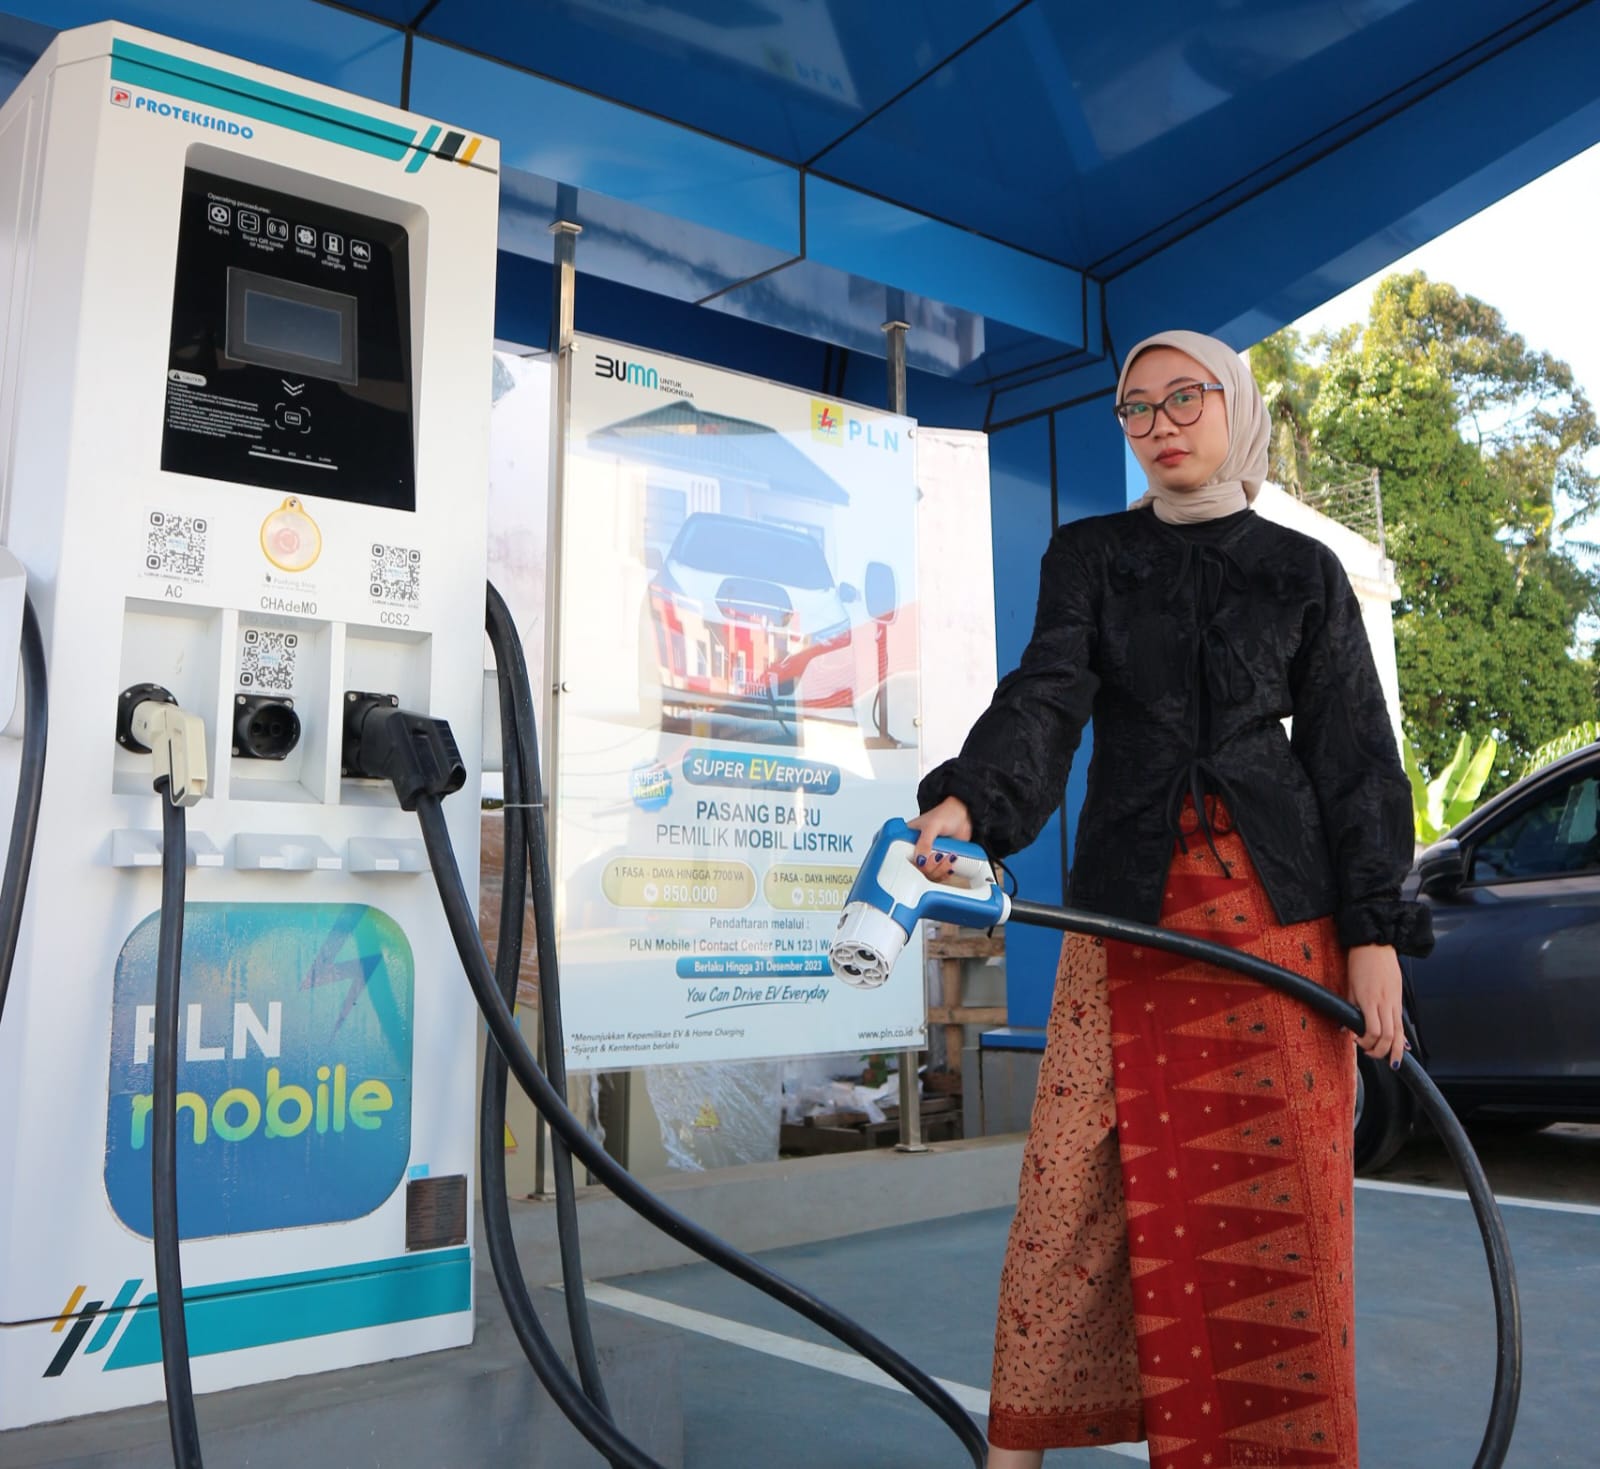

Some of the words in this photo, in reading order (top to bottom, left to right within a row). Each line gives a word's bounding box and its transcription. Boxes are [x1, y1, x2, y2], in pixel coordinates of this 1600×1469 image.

[135, 96, 254, 140] PROTEKSINDO
[659, 377, 682, 388] UNTUK
[659, 385, 695, 399] INDONESIA
[849, 418, 899, 452] PLN
[165, 584, 183, 599] AC
[260, 596, 318, 616] CHAdeMO
[380, 611, 410, 626] CCS2
[693, 758, 745, 779] SUPER
[696, 800, 770, 825] PASANG
[775, 805, 821, 828] BARU
[656, 823, 730, 848] PEMILIK
[734, 828, 788, 851] MOBIL
[793, 831, 854, 853] LISTRIK
[622, 867, 645, 879] FASA
[652, 867, 674, 880] DAYA
[676, 868, 711, 881] HINGGA
[780, 872, 799, 884] FASA
[804, 873, 823, 884] DAYA
[825, 874, 853, 885] HINGGA
[663, 884, 718, 904] 850.000
[709, 916, 769, 930] Pendaftaran
[771, 918, 805, 930] melalui
[629, 938, 652, 952] PLN
[655, 938, 690, 952] Mobile
[699, 939, 738, 952] Contact
[741, 939, 773, 952] Center
[775, 939, 794, 952] PLN
[797, 939, 813, 952] 123
[694, 960, 724, 973] Berlaku
[725, 961, 753, 975] Hingga
[755, 961, 764, 972] 31
[766, 960, 803, 972] Desember
[804, 960, 822, 971] 2023
[686, 986, 707, 1003] You
[709, 986, 730, 1002] Can
[732, 985, 761, 1002] Drive
[765, 985, 783, 1001] EV
[781, 983, 830, 1004] Everyday
[133, 1001, 282, 1065] PLN
[627, 1030, 671, 1042] Kepemilikan
[673, 1029, 684, 1039] EV
[692, 1029, 713, 1038] Home
[714, 1027, 745, 1039] Charging
[857, 1027, 914, 1041] www.pln.co.id
[608, 1042, 651, 1053] Kententuan
[652, 1040, 680, 1052] berlaku
[130, 1063, 393, 1150] mobile
